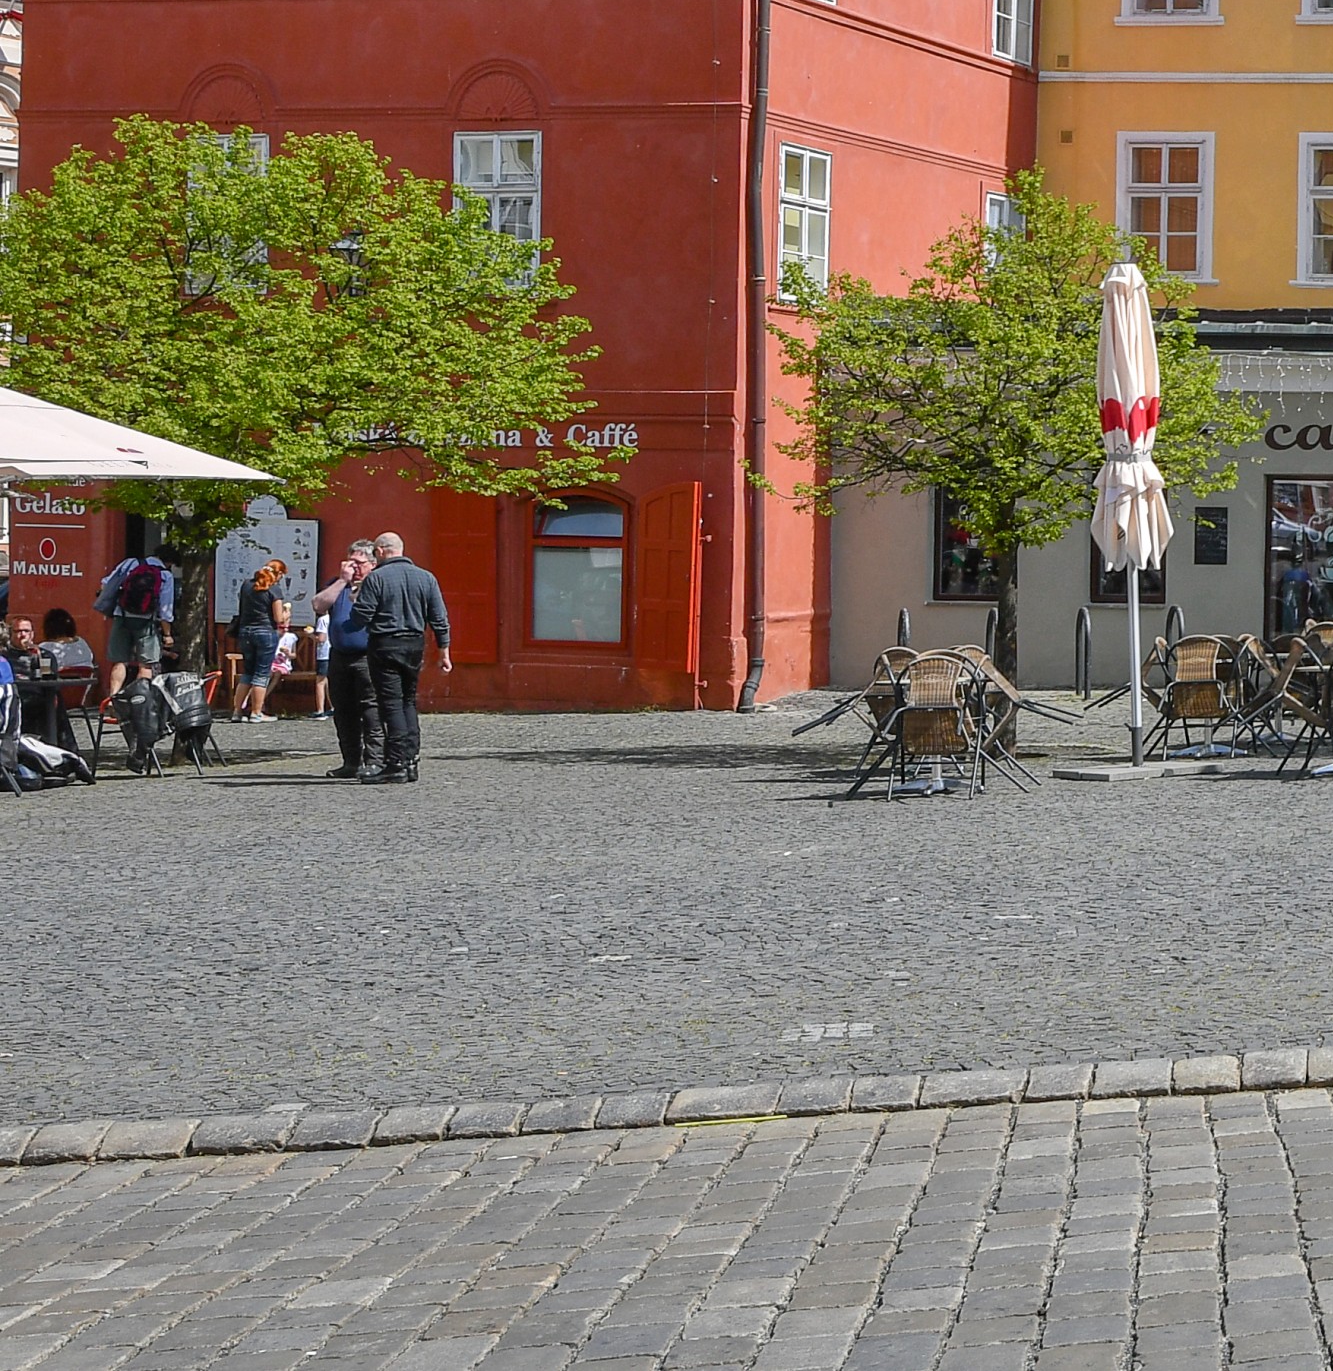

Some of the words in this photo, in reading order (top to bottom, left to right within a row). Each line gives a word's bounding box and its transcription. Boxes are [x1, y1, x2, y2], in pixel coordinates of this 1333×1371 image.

[534, 424, 554, 447] &
[566, 422, 639, 447] Caffé
[13, 560, 83, 577] MANUEL
